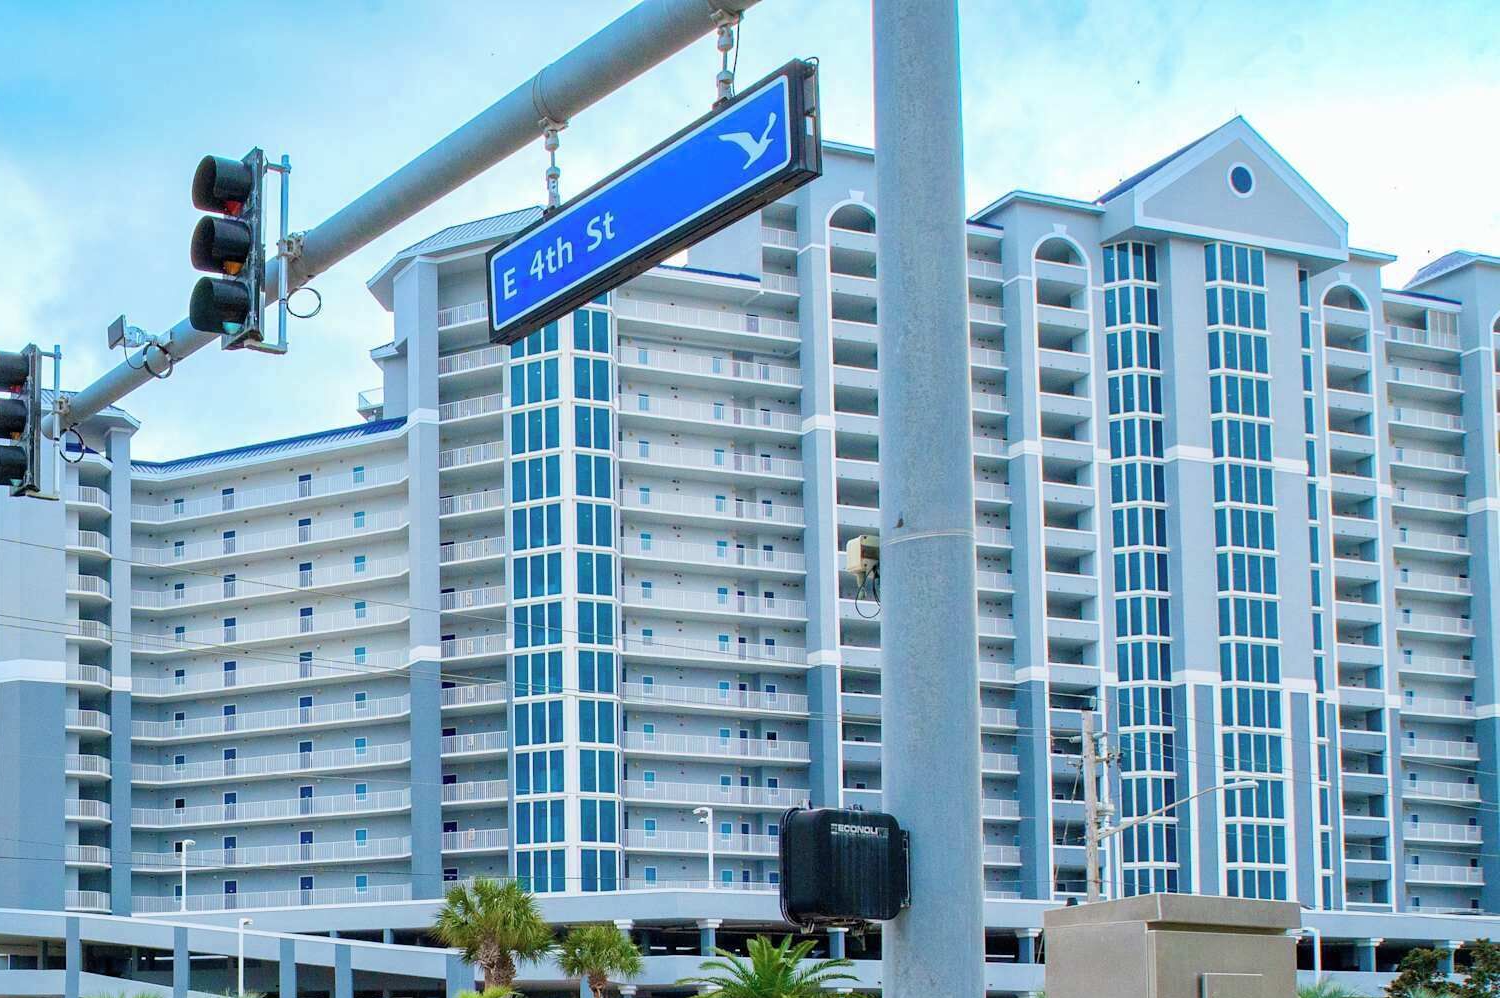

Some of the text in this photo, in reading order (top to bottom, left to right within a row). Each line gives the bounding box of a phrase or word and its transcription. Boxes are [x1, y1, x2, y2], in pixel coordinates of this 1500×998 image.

[503, 211, 616, 300] E 4th St
[838, 824, 889, 837] ECONOLI
